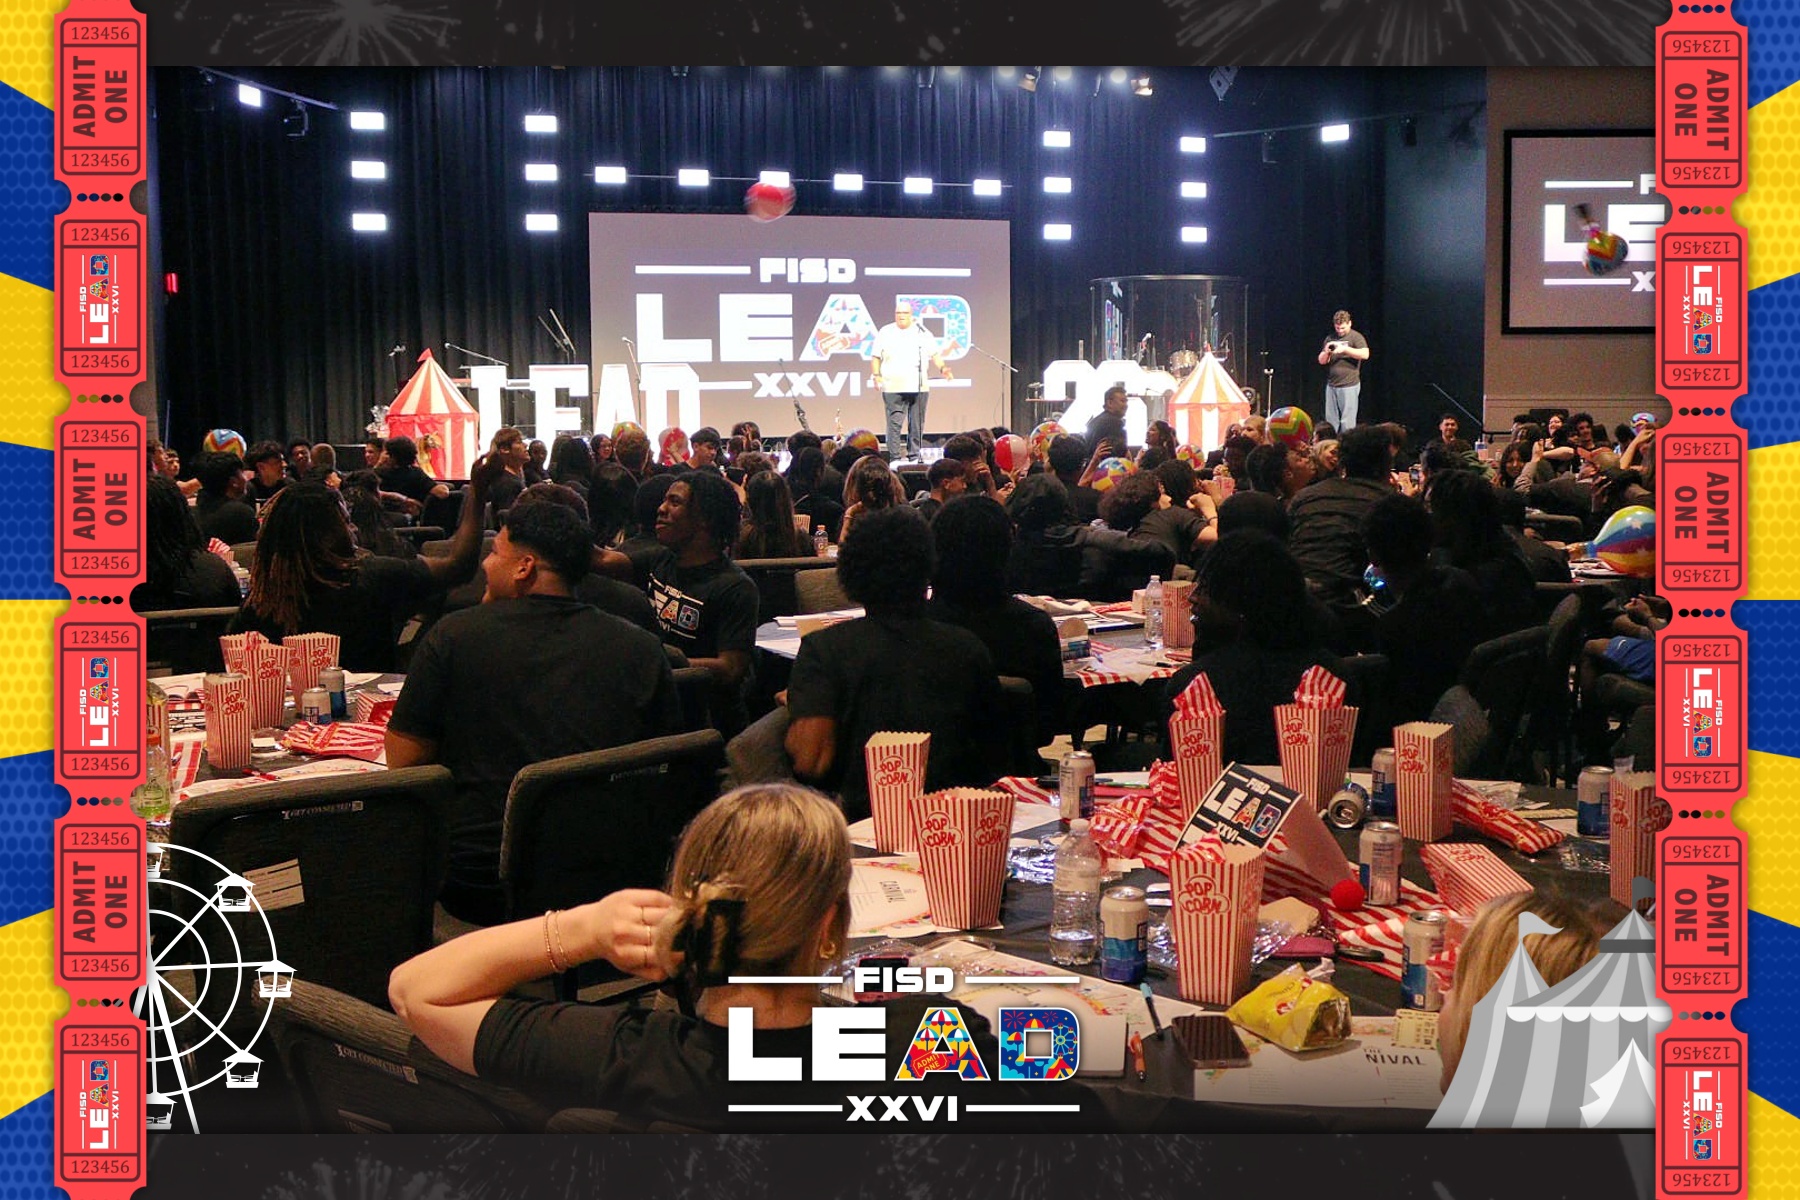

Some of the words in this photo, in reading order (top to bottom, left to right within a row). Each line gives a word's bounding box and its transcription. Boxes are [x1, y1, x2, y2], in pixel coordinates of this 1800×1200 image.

[1543, 203, 1665, 262] LE
[759, 257, 856, 283] FISD
[636, 293, 972, 362] LEAD
[754, 371, 861, 397] XXVI
[313, 648, 327, 657] POP
[261, 660, 276, 669] POP
[260, 669, 280, 680] CORN
[225, 693, 241, 705] POP
[225, 701, 244, 715] CORN
[1284, 722, 1302, 734] POP
[1183, 732, 1203, 745] POP
[1182, 743, 1210, 758] CORN
[1399, 747, 1419, 759] POP
[880, 760, 901, 773] POP
[878, 772, 908, 787] CORN
[1246, 777, 1271, 796] FISD
[1203, 780, 1282, 839] LEAD
[925, 817, 948, 832] POP
[979, 815, 999, 831] POP
[926, 831, 956, 847] CORN
[1216, 821, 1240, 842] XXVI
[1184, 881, 1213, 898] POP
[1185, 897, 1222, 914] CORN
[1365, 1053, 1427, 1066] NIVAL
